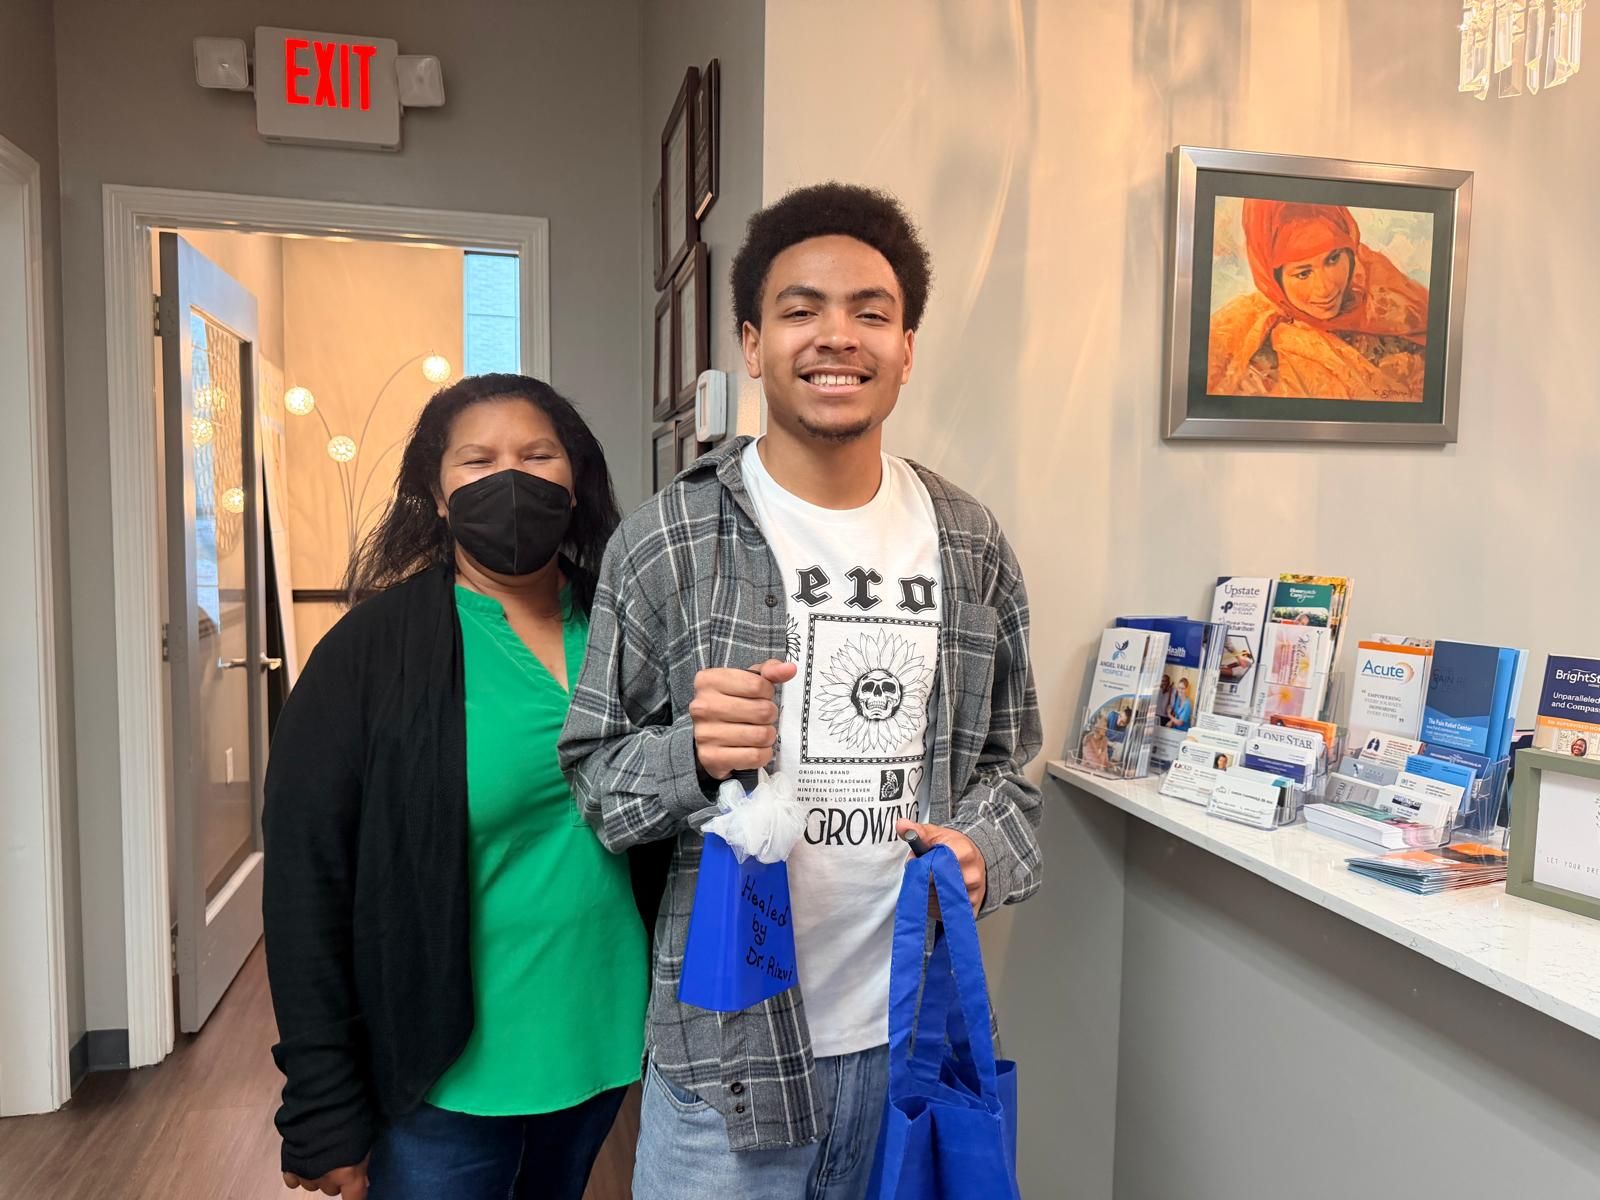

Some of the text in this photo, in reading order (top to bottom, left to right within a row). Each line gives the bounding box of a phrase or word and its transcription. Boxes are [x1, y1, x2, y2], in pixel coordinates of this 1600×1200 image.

[285, 37, 377, 112] EXIT
[1224, 584, 1260, 598] Upstate
[1099, 660, 1136, 672] ANGEL VALLEY
[1362, 659, 1404, 678] Acute
[1551, 701, 1566, 709] and
[1553, 691, 1600, 704] Unparalleled
[1546, 856, 1559, 865] LET
[1564, 860, 1581, 870] YOUR
[741, 875, 790, 927] Healed
[751, 912, 768, 946] by
[746, 946, 794, 982] Dr. Rizvi
